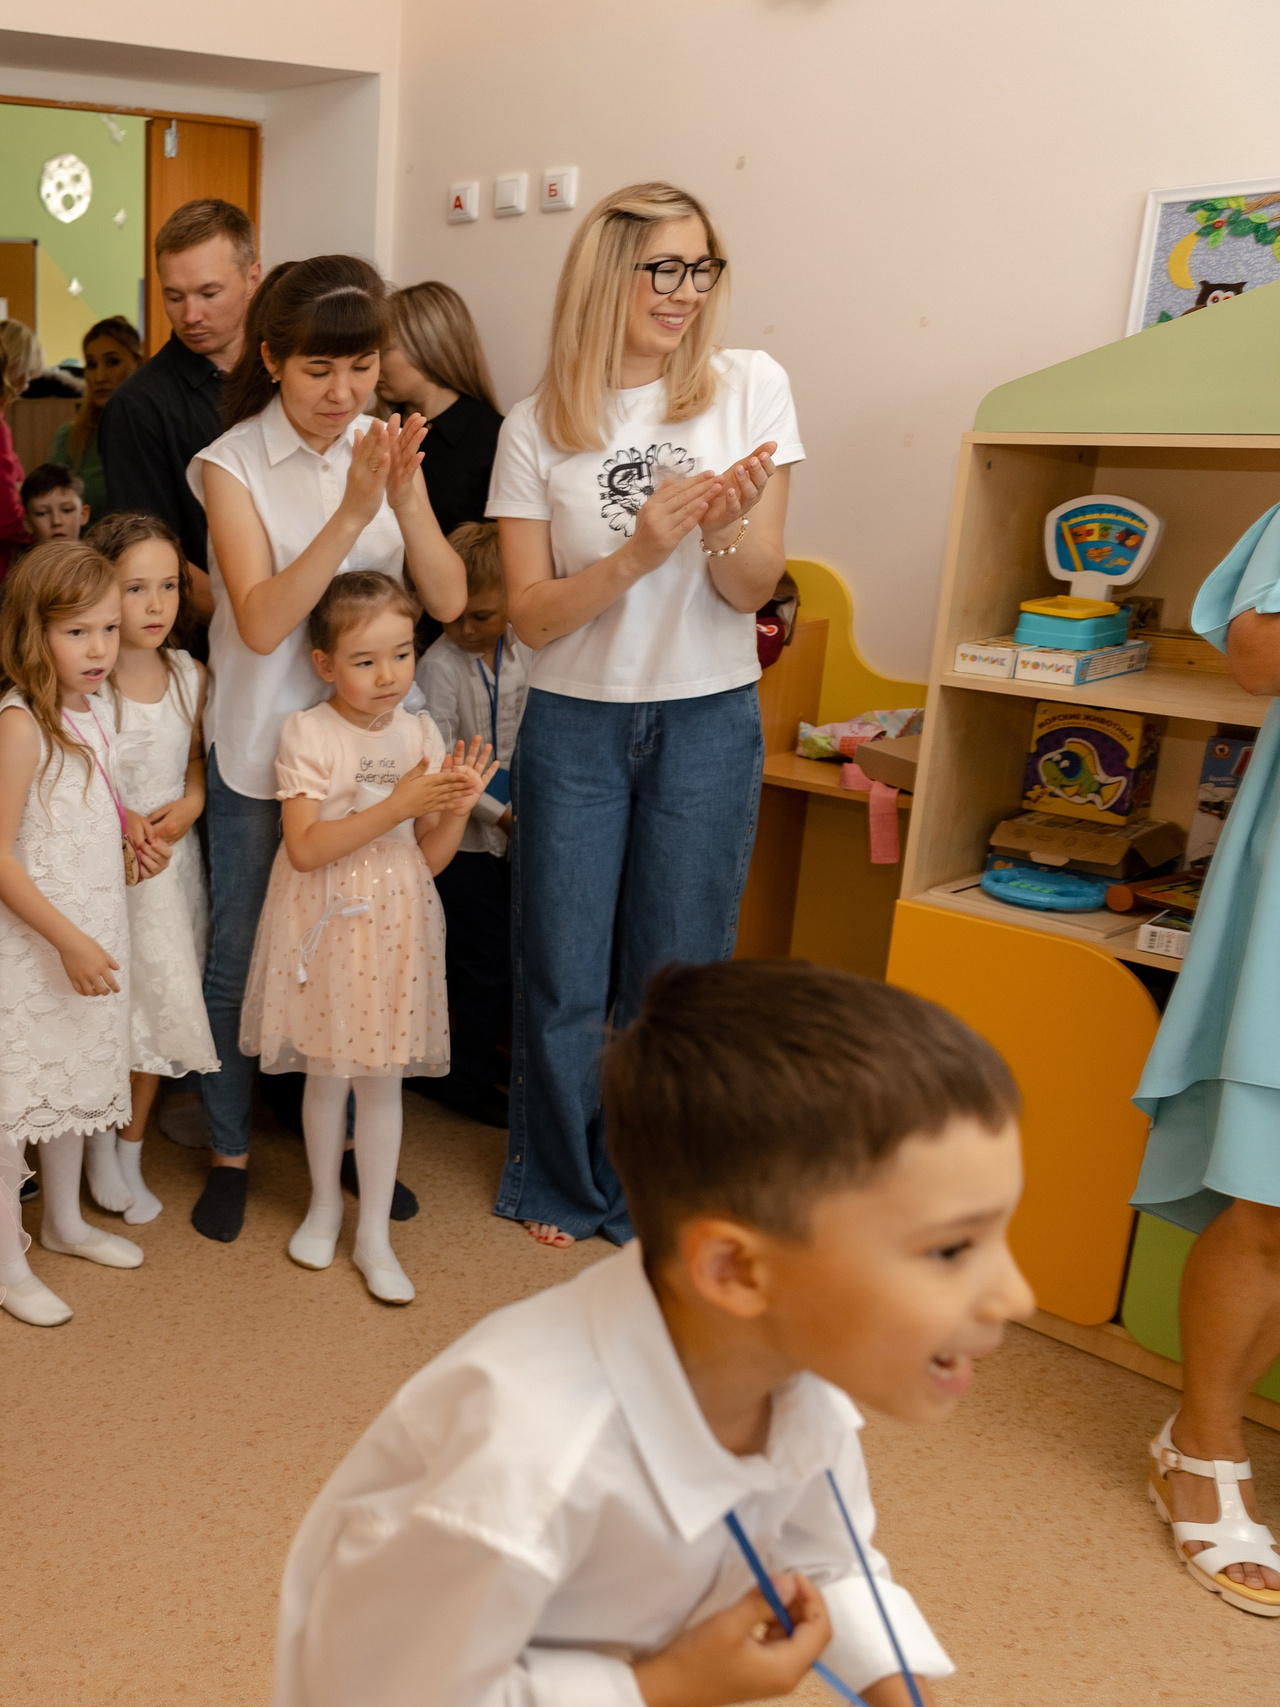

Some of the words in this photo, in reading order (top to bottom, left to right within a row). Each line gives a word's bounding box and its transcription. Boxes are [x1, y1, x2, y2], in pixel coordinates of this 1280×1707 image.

[548, 183, 558, 198] Б
[960, 652, 1006, 667] ТОМИК
[1020, 660, 1073, 674] ТОМИК
[378, 757, 396, 768] nice
